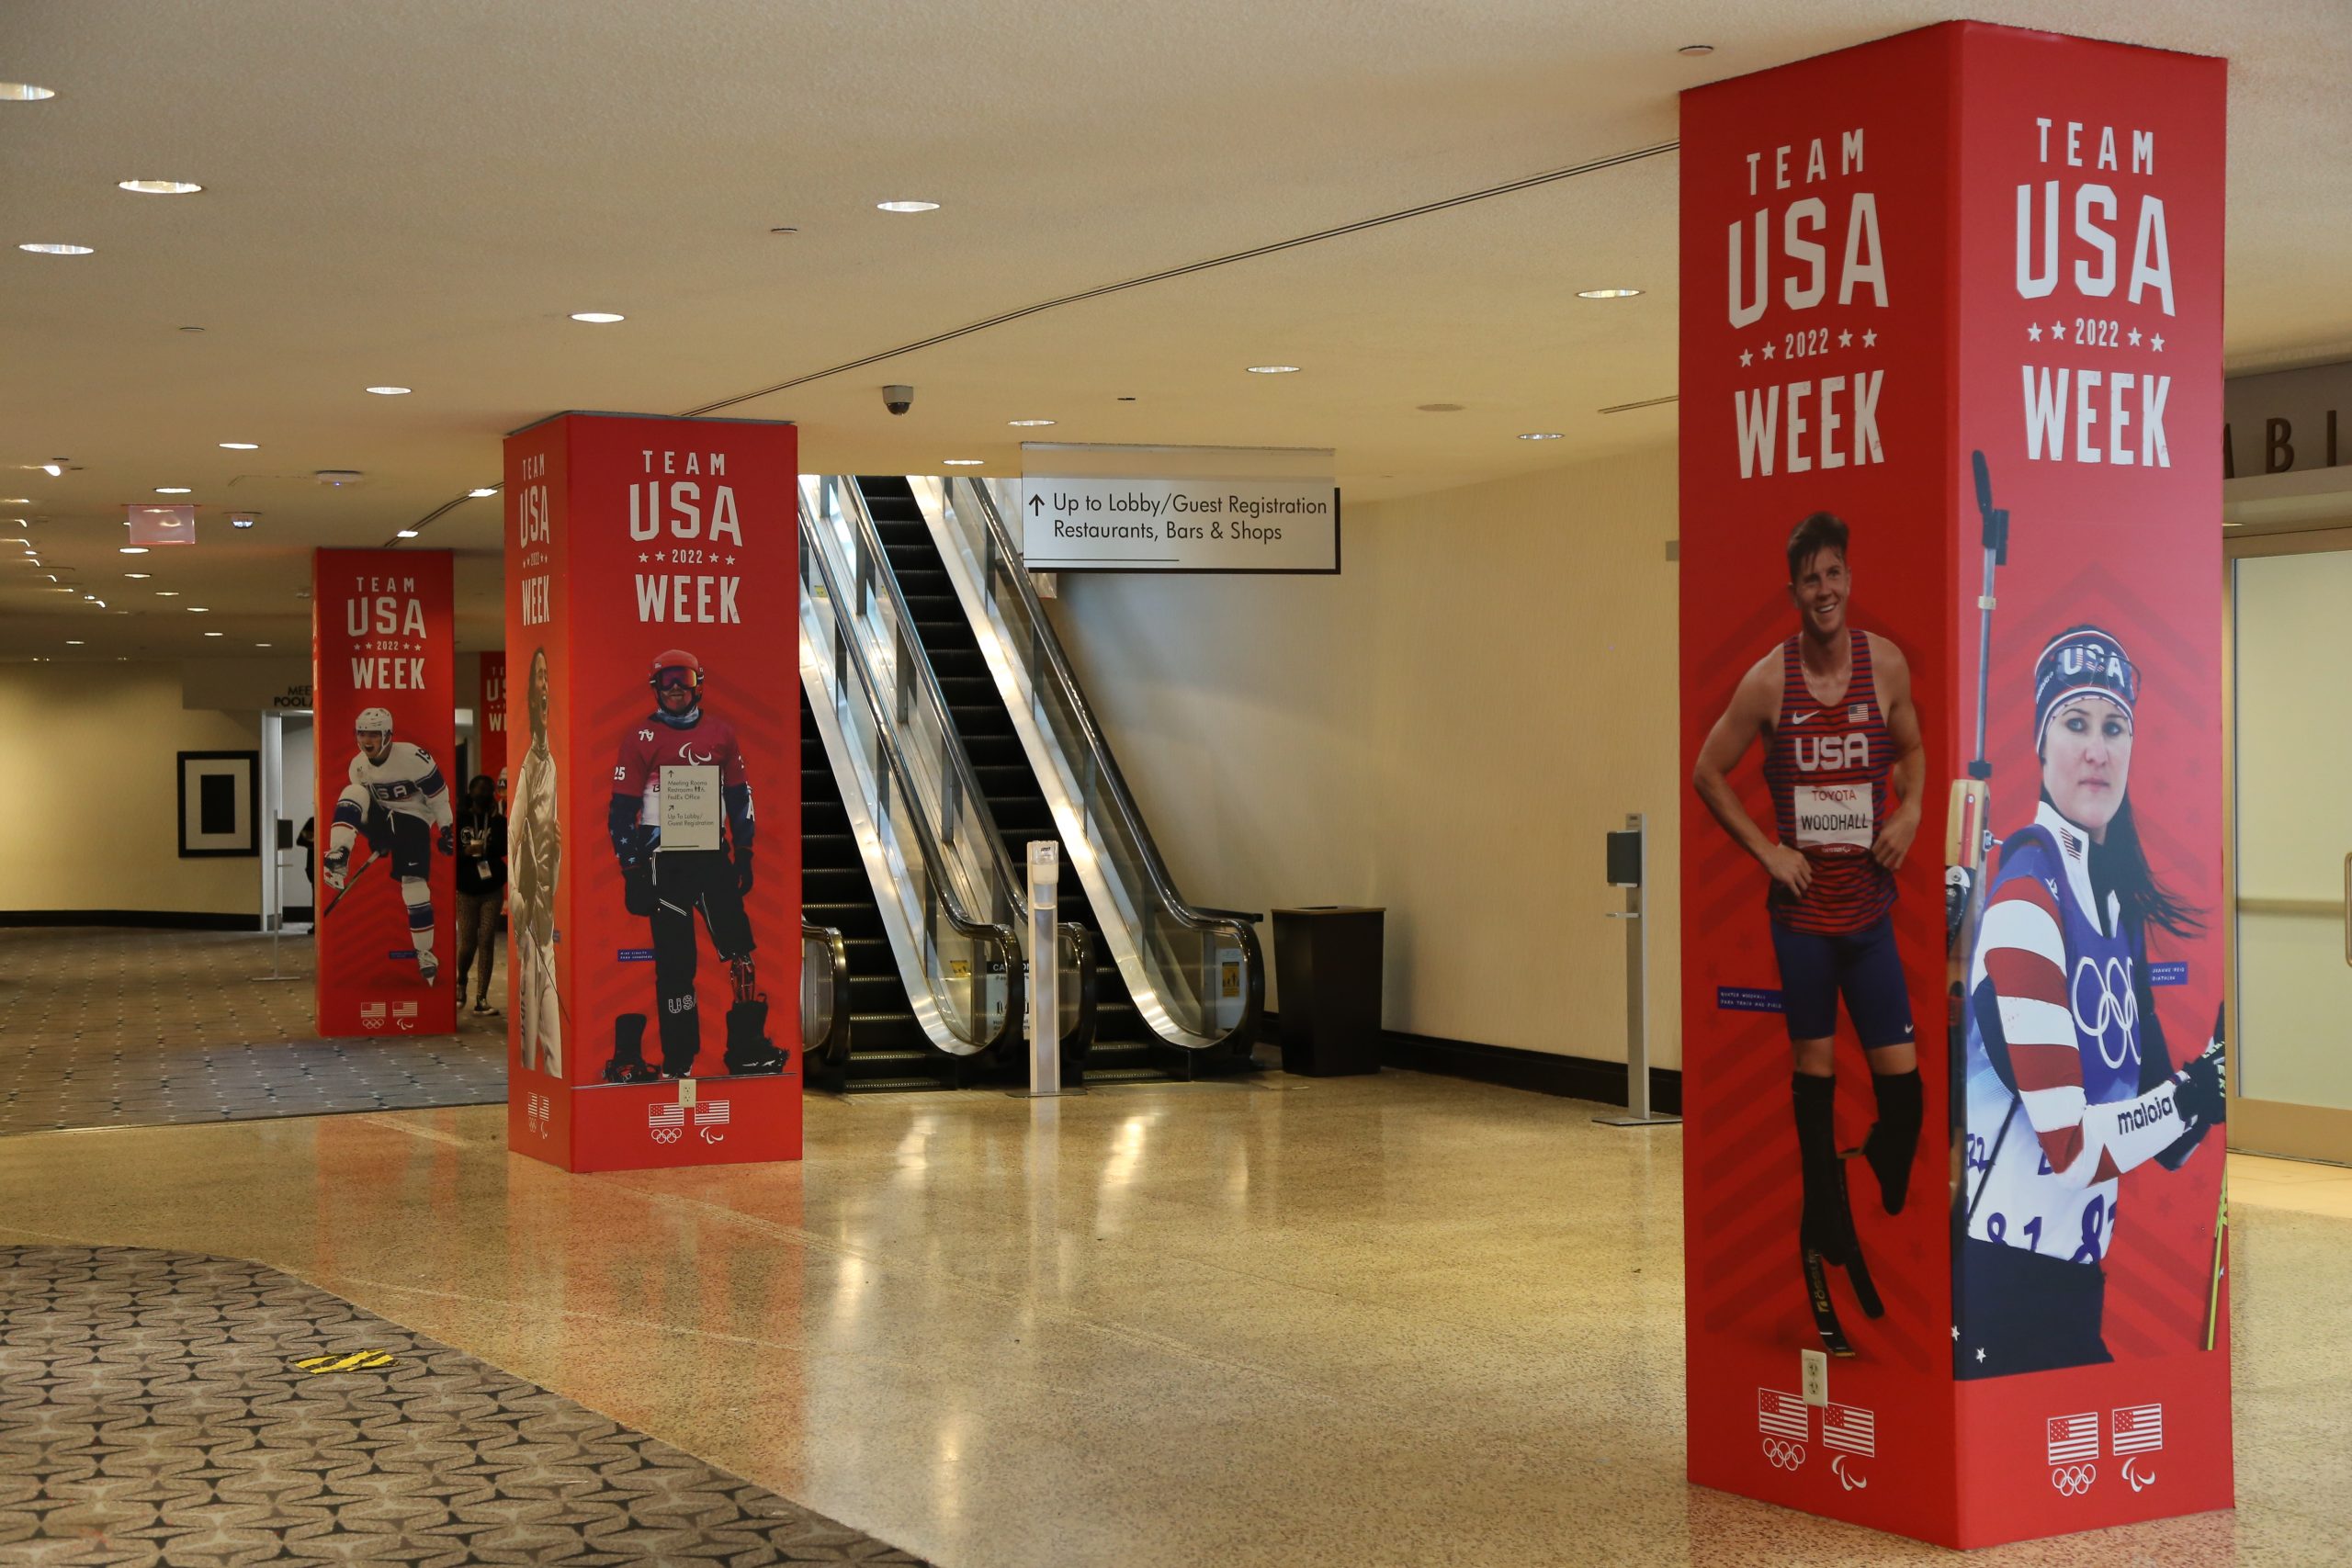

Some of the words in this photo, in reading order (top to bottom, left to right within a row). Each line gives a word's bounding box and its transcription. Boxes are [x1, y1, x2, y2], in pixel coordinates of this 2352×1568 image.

[1747, 129, 1864, 196] TEAM
[2036, 117, 2154, 175] TEAM
[1728, 193, 1889, 329] USA
[2017, 180, 2176, 317] USA
[1785, 328, 1828, 359] 2022
[2075, 318, 2119, 348] 2022
[1735, 370, 1885, 479] WEEK
[2022, 365, 2171, 468] WEEK
[523, 454, 545, 481] TEAM
[643, 450, 725, 476] TEAM
[520, 485, 549, 549] USA
[629, 481, 742, 547] USA
[1054, 492, 1079, 516] Up
[1086, 495, 1102, 512] to
[1109, 492, 1223, 517] Lobby/Guest
[1229, 495, 1328, 517] Registration
[1054, 520, 1159, 542] Restaurants,
[1167, 521, 1204, 539] Bars
[1211, 522, 1224, 539] &
[1231, 521, 1282, 544] Shops
[672, 549, 703, 563] 2022
[356, 577, 414, 592] TEAM
[522, 575, 549, 626] WEEK
[635, 574, 741, 624] WEEK
[347, 597, 426, 638] USA
[377, 640, 399, 651] 2022
[351, 657, 425, 689] WEEK
[2064, 644, 2125, 688] USA
[1795, 732, 1869, 771] USA
[377, 784, 407, 799] SA
[1812, 789, 1857, 802] TOYOTA
[1801, 813, 1869, 830] WOODHALL
[2118, 1097, 2173, 1135] maloja
